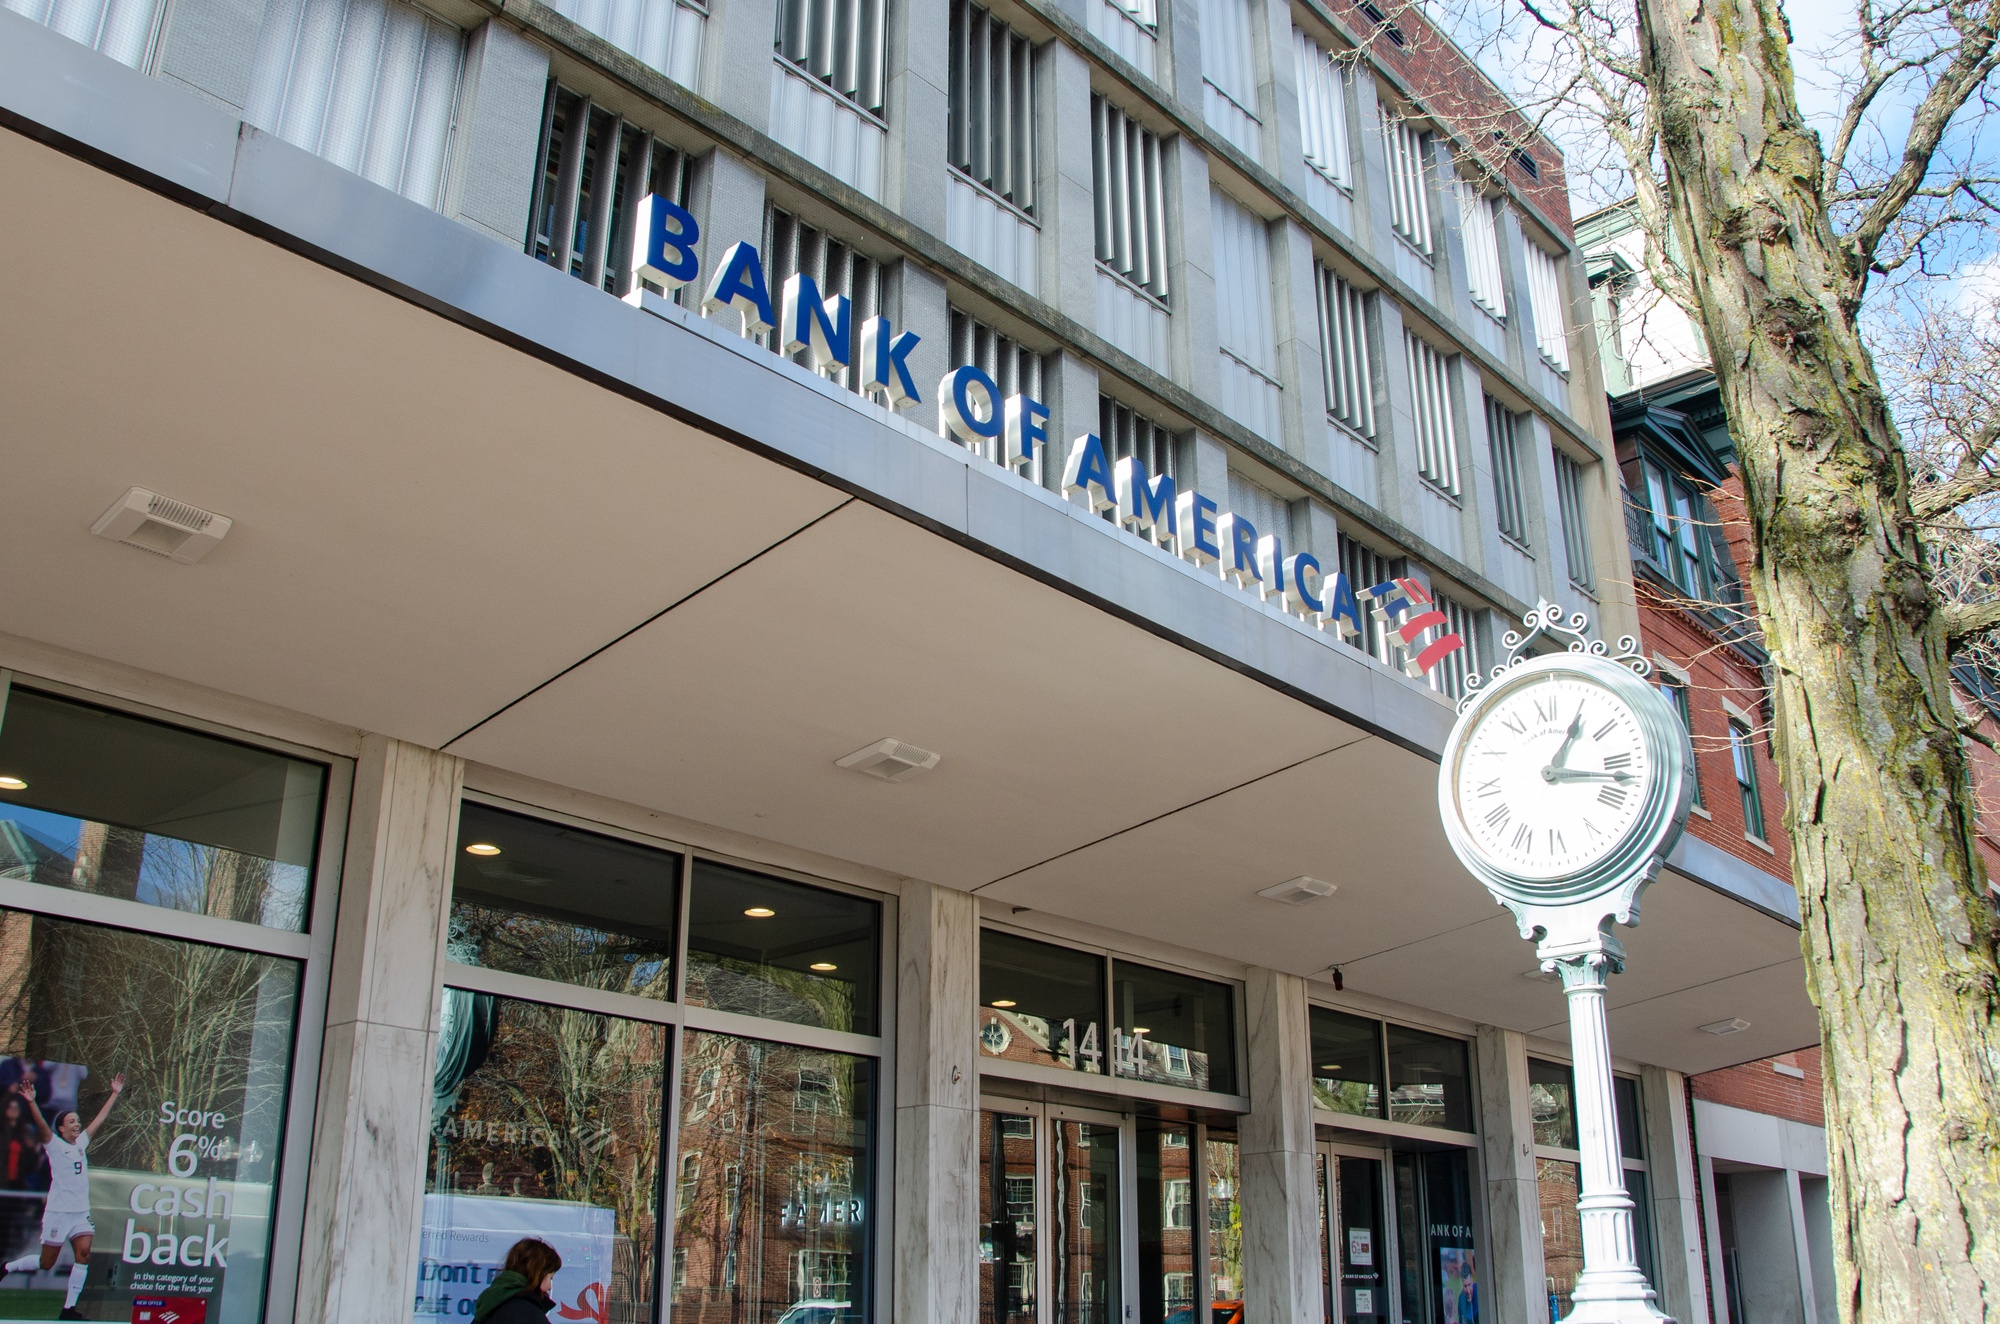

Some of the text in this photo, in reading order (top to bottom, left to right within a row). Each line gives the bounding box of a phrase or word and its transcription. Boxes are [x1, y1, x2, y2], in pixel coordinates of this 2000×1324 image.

[634, 193, 1361, 637] BANK OF AMERICA
[159, 1101, 226, 1129] Score
[442, 1117, 562, 1149] AMERICA
[74, 1161, 82, 1175] 9
[168, 1133, 222, 1178] 6%
[130, 1176, 233, 1220] cash
[121, 1218, 229, 1268] back
[421, 1230, 490, 1243] erred Rewards
[1430, 1223, 1450, 1237] ANK
[1452, 1224, 1464, 1238] OF
[133, 1271, 215, 1285] in the category of your
[420, 1259, 483, 1284] Don't
[129, 1281, 214, 1295] choice for the first year
